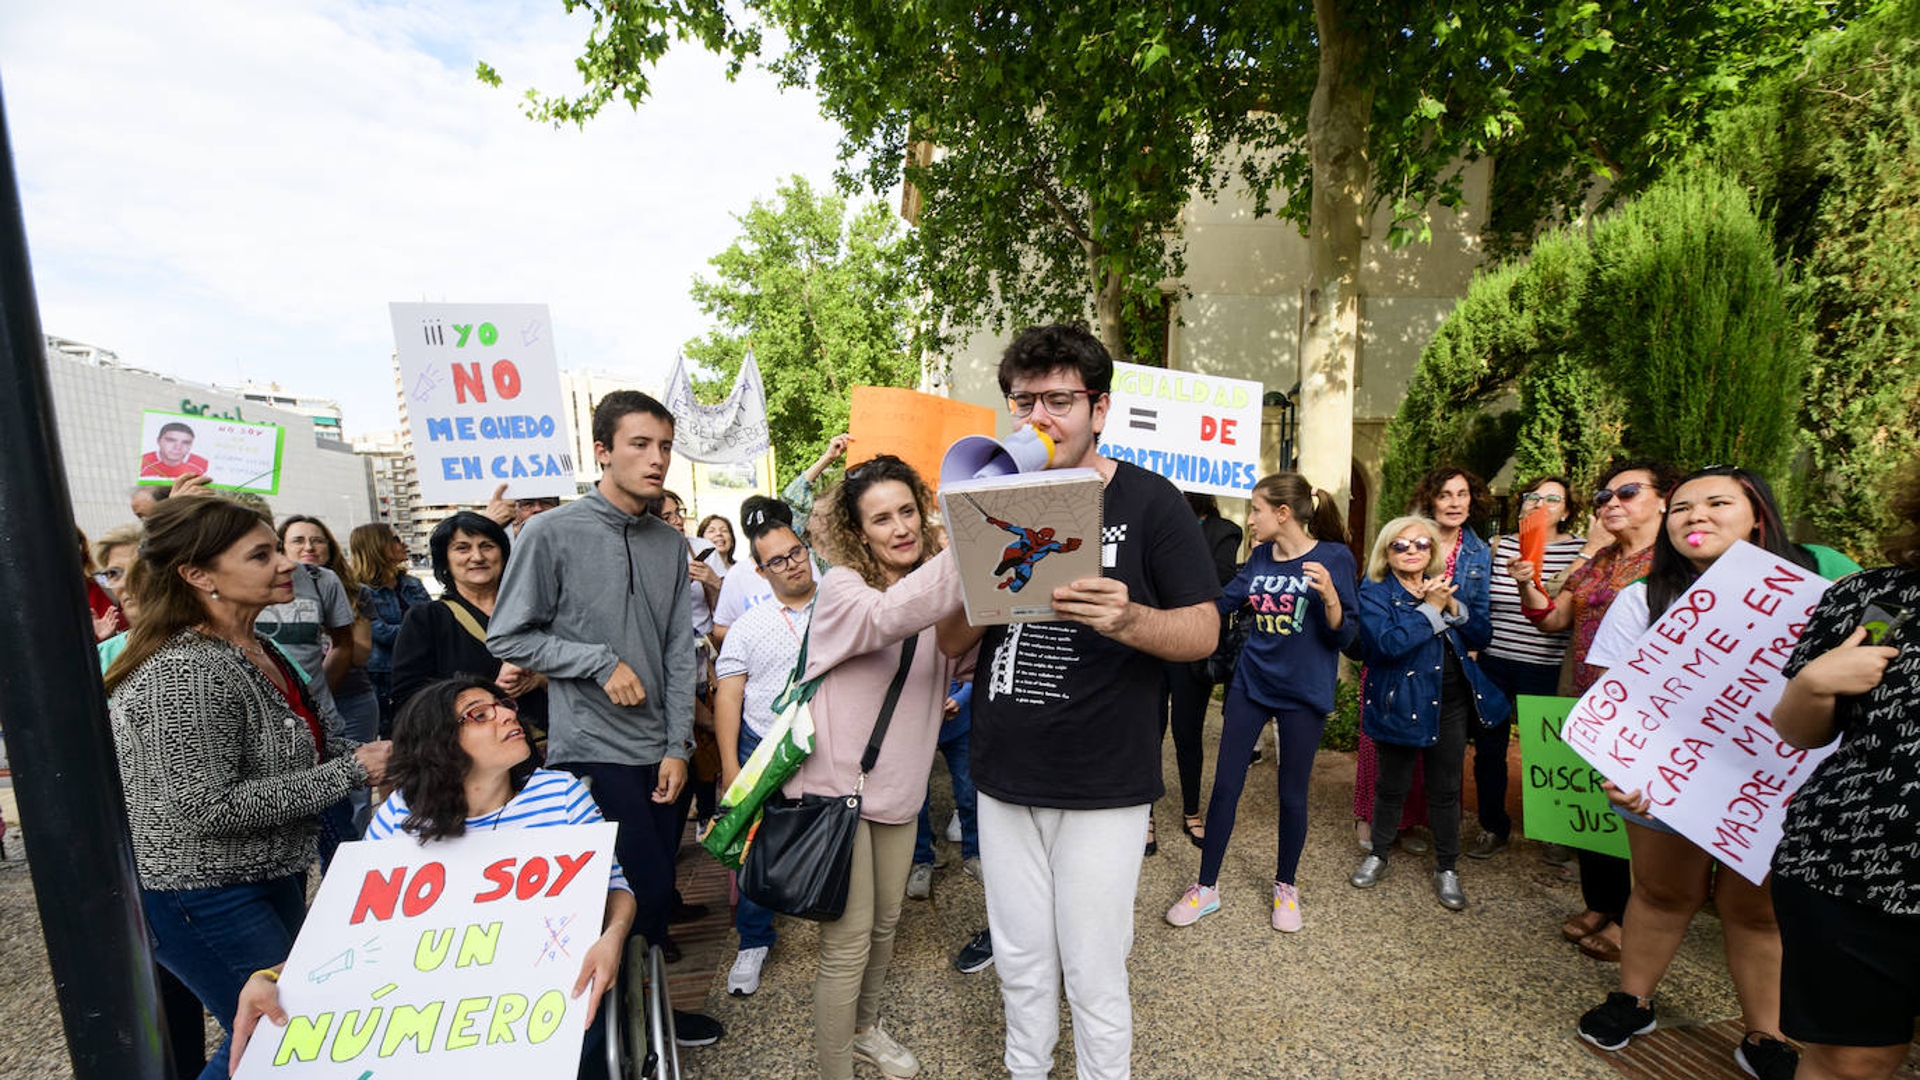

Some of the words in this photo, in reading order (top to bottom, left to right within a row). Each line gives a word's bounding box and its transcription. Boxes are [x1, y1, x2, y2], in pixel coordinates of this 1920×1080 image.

[451, 359, 521, 404] NO
[1110, 367, 1249, 409] IGUALDAD
[426, 417, 476, 441] ME
[480, 415, 555, 439] QUEDO
[1200, 415, 1237, 445] DE
[441, 456, 483, 480] EN
[1097, 443, 1257, 491] OPORTUNIDADES
[1249, 575, 1312, 594] FUN
[1567, 679, 1628, 757] TENGO
[1628, 589, 1716, 675] MIEDO
[1646, 737, 1715, 807] CASA
[349, 861, 446, 925] NO
[473, 850, 596, 904] SOY
[413, 921, 503, 972] UN
[272, 982, 566, 1067] NÚMERO
